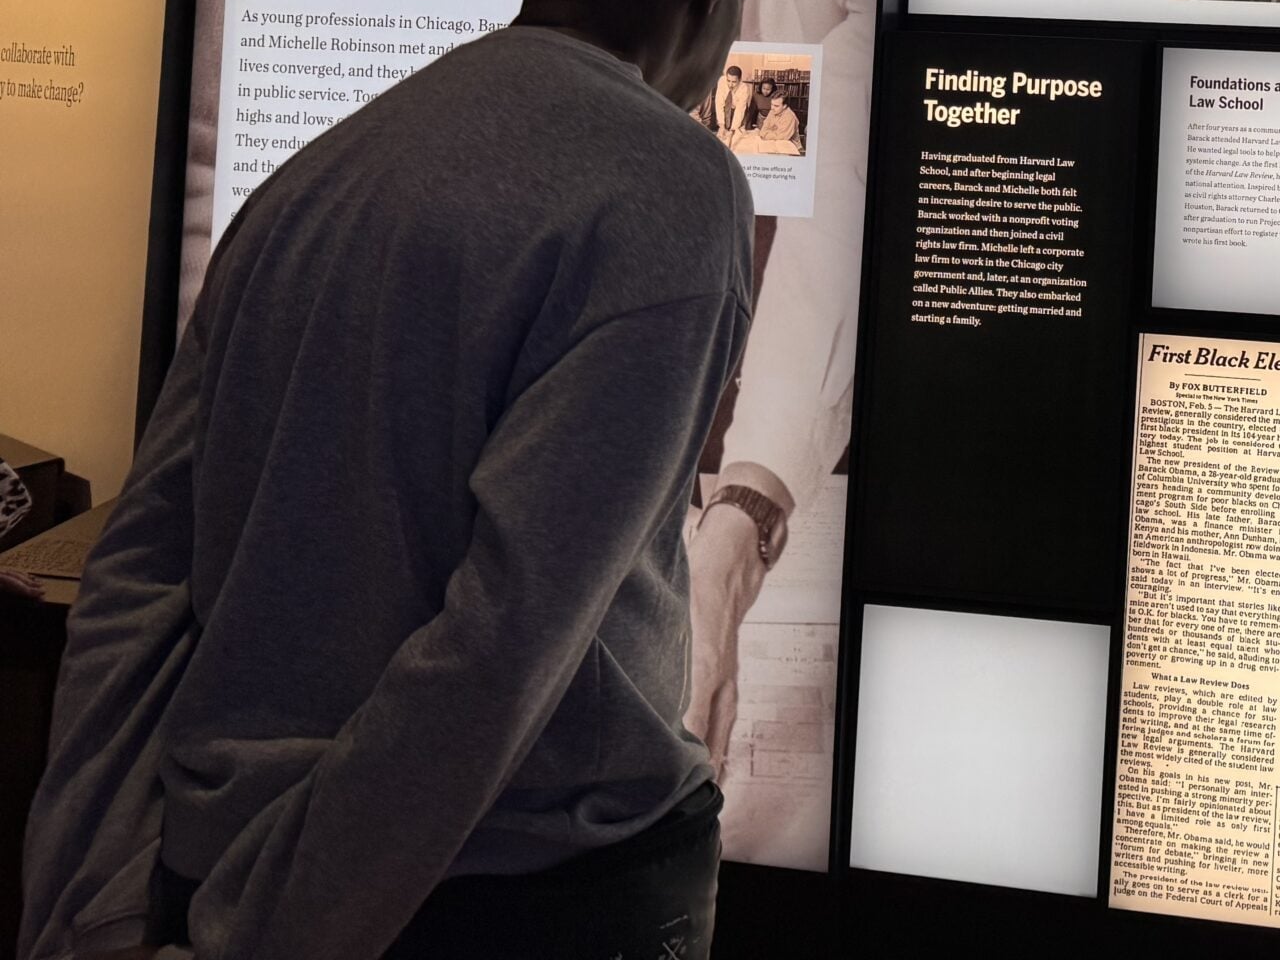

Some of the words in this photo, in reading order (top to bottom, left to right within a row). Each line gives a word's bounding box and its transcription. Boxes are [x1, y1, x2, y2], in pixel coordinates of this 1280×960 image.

[241, 9, 258, 22] As
[260, 13, 303, 27] young
[305, 12, 395, 28] professionals
[399, 15, 412, 28] in
[415, 16, 474, 34] Chicago,
[240, 34, 265, 47] and
[268, 35, 327, 50] Michelle
[330, 37, 395, 53] Robinson
[399, 42, 425, 54] met
[0, 41, 52, 65] collaborate
[53, 44, 75, 67] with
[239, 58, 269, 72] lives
[272, 62, 345, 78] converged,
[348, 63, 373, 78] and
[377, 64, 408, 81] they
[925, 68, 1007, 98] Finding
[1012, 71, 1102, 101] Purpose
[1190, 75, 1271, 91] Foundations
[6, 78, 16, 96] to
[17, 77, 42, 99] make
[43, 79, 84, 108] change?
[238, 83, 250, 97] in
[253, 84, 296, 101] public
[298, 87, 349, 102] service.
[1189, 94, 1215, 108] Law
[1218, 95, 1263, 110] School
[236, 107, 272, 125] highs
[274, 110, 299, 124] and
[303, 111, 334, 127] lows
[923, 99, 1020, 127] Together
[1205, 123, 1220, 131] four
[235, 133, 269, 150] They
[271, 135, 310, 149] endu
[233, 159, 257, 172] and
[921, 151, 952, 163] Having
[952, 153, 995, 163] graduated
[996, 154, 1018, 164] from
[1019, 155, 1055, 166] Harvard
[1056, 158, 1075, 167] Law
[919, 165, 951, 176] School,
[951, 167, 968, 176] and
[969, 168, 991, 177] after
[991, 169, 1035, 181] beginning
[1035, 171, 1055, 182] legal
[918, 182, 952, 191] careers,
[953, 182, 983, 192] Barack
[984, 184, 1001, 193] and
[1002, 184, 1039, 195] Michelle
[1040, 186, 1061, 196] both
[1062, 187, 1077, 197] felt
[911, 313, 945, 325] starting
[952, 314, 981, 327] family.
[1147, 344, 1192, 364] First
[1193, 347, 1250, 368] Black
[1169, 381, 1180, 391] By
[1181, 382, 1200, 391] FOX
[1202, 384, 1267, 396] BUTTERFIELD
[1139, 406, 1173, 417] Review,
[1174, 410, 1212, 420] generally
[1213, 413, 1257, 422] considered
[1258, 415, 1270, 424] the
[1151, 672, 1171, 681] What
[1180, 675, 1198, 684] Law
[1199, 677, 1229, 687] Review
[1230, 681, 1250, 690] Does
